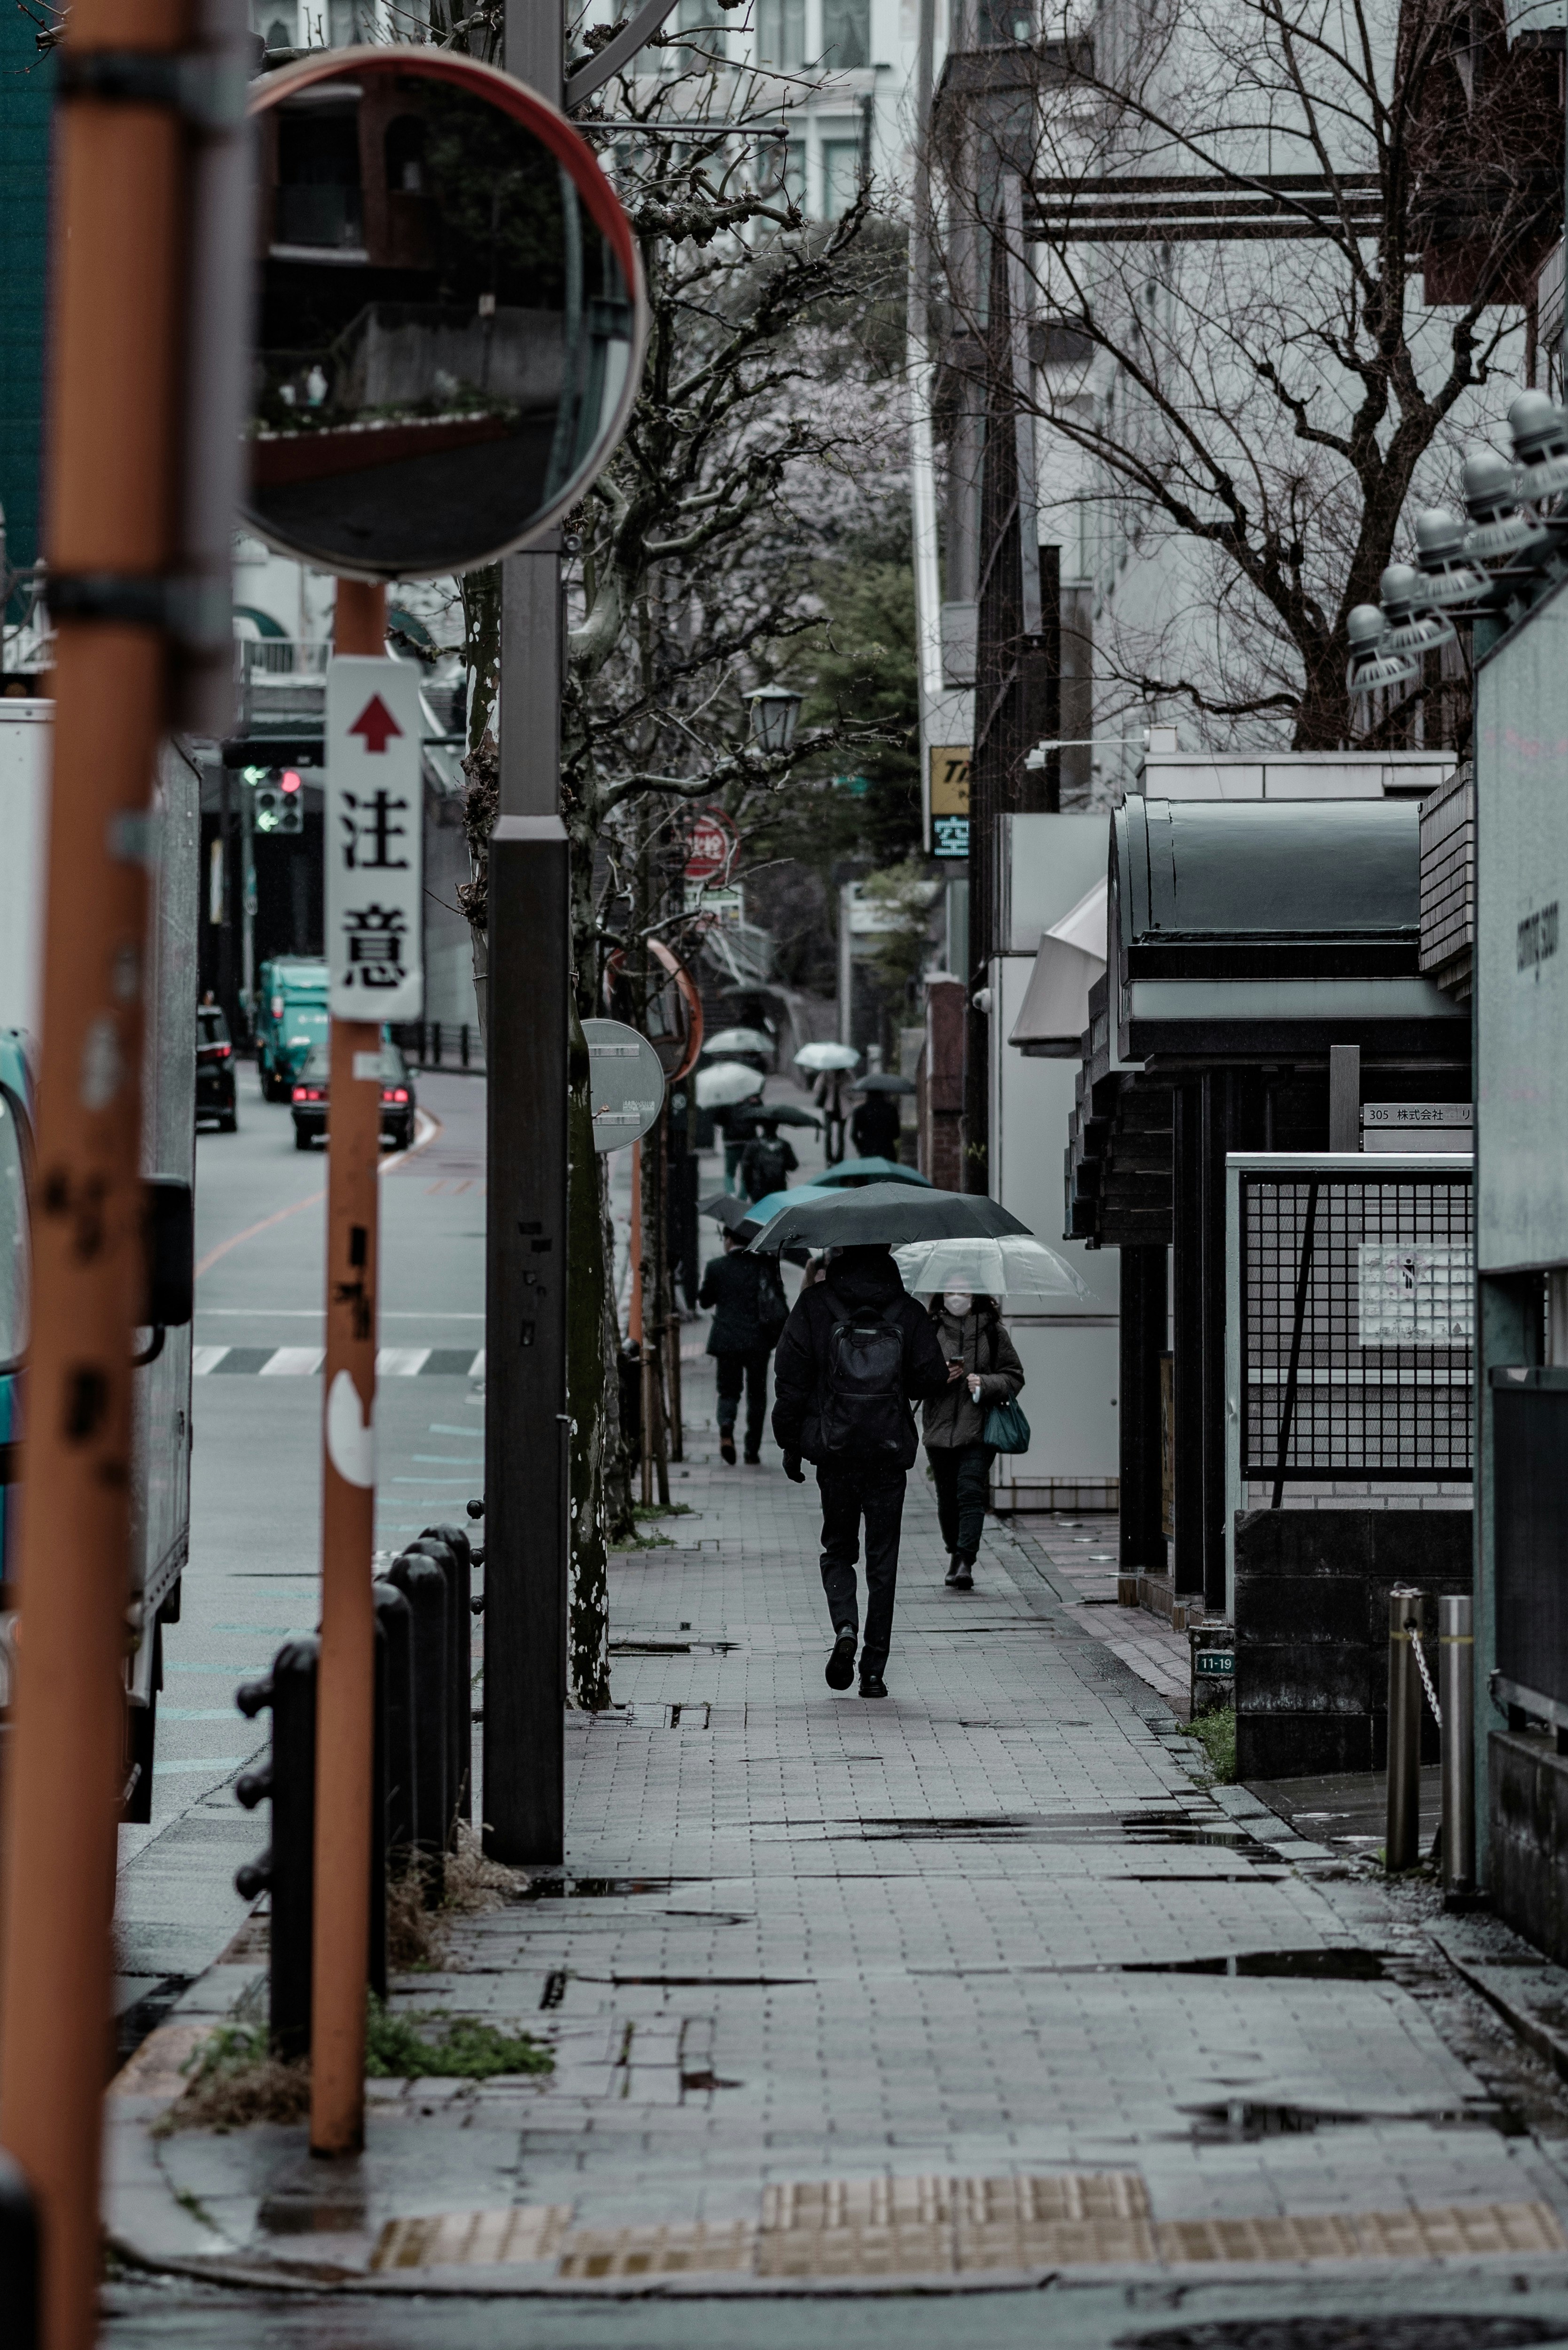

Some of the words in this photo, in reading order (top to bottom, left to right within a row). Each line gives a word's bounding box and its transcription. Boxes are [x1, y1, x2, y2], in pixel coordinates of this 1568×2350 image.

[934, 816, 969, 855] 空
[341, 789, 409, 988] 注意
[1369, 1110, 1389, 1120] 305
[1397, 1109, 1443, 1121] 株式会社
[1201, 1658, 1232, 1669] 11-19
